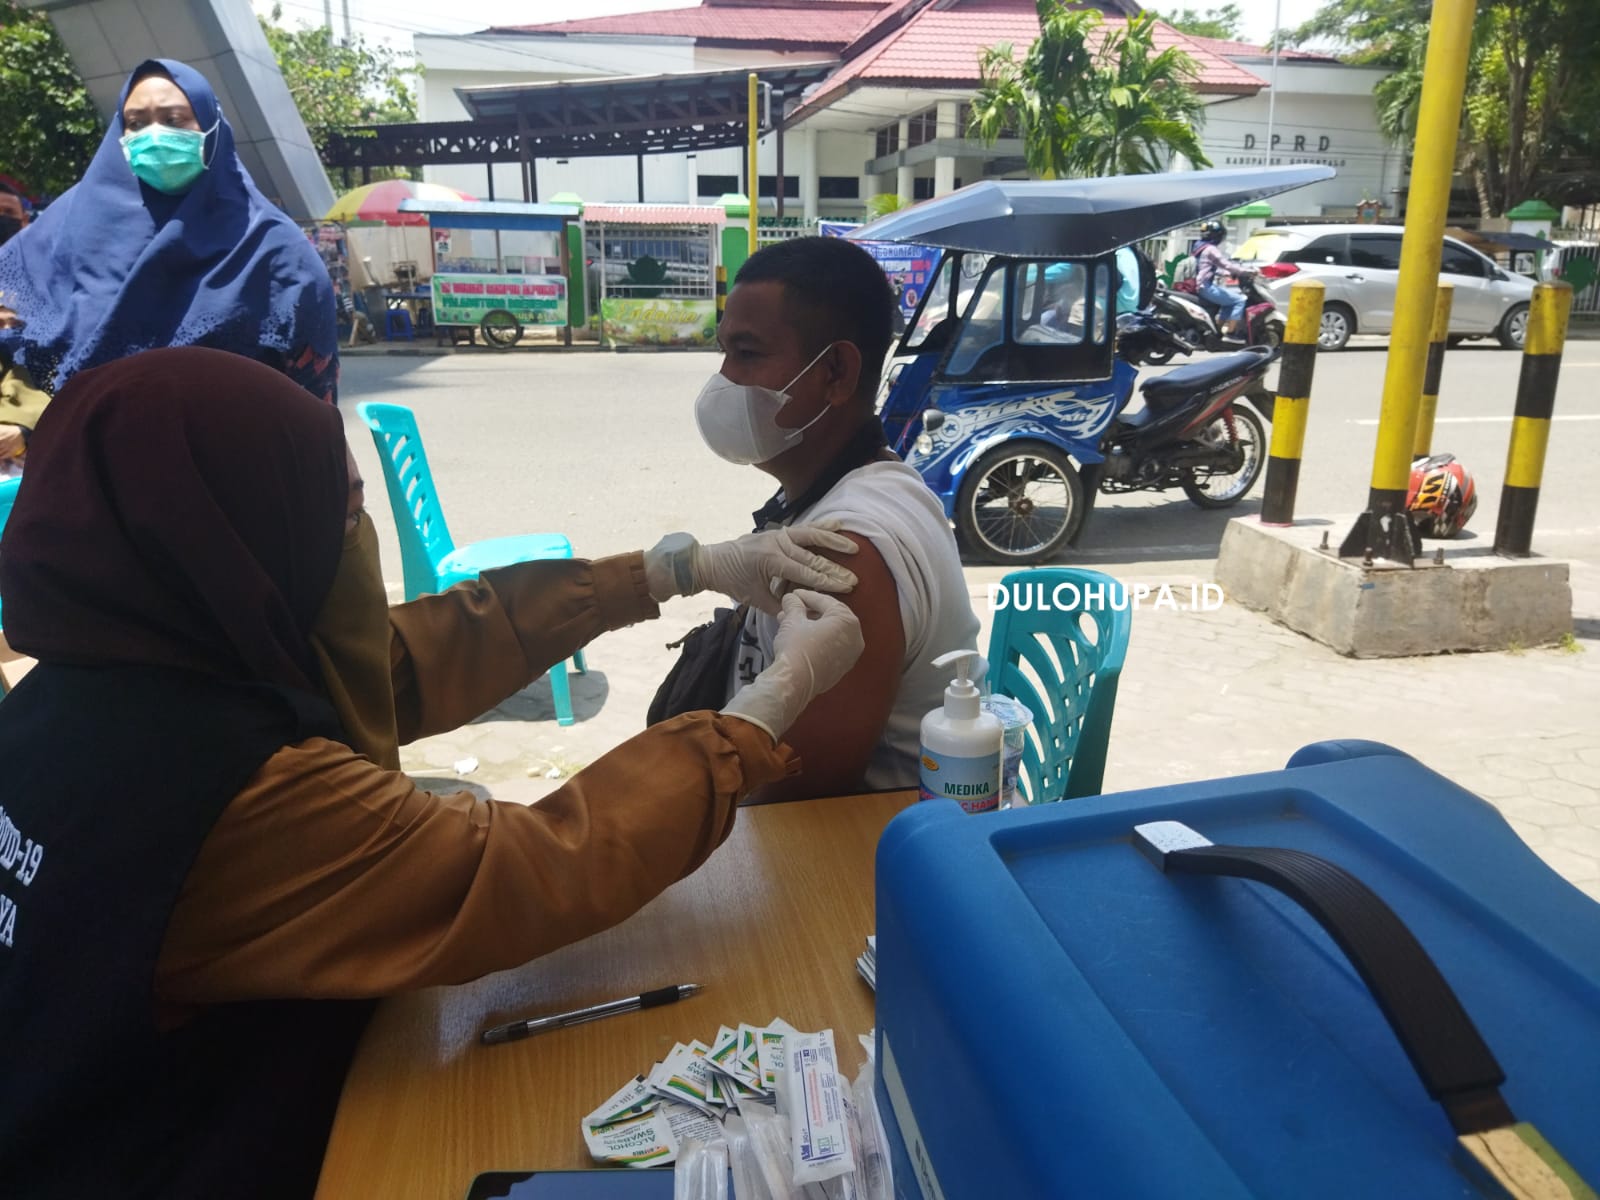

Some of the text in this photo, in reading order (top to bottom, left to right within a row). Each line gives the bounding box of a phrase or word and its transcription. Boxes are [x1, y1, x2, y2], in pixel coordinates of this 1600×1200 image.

[1244, 134, 1330, 152] DPRD
[943, 781, 990, 796] MEDIKA
[607, 1134, 656, 1151] ALCOHOL
